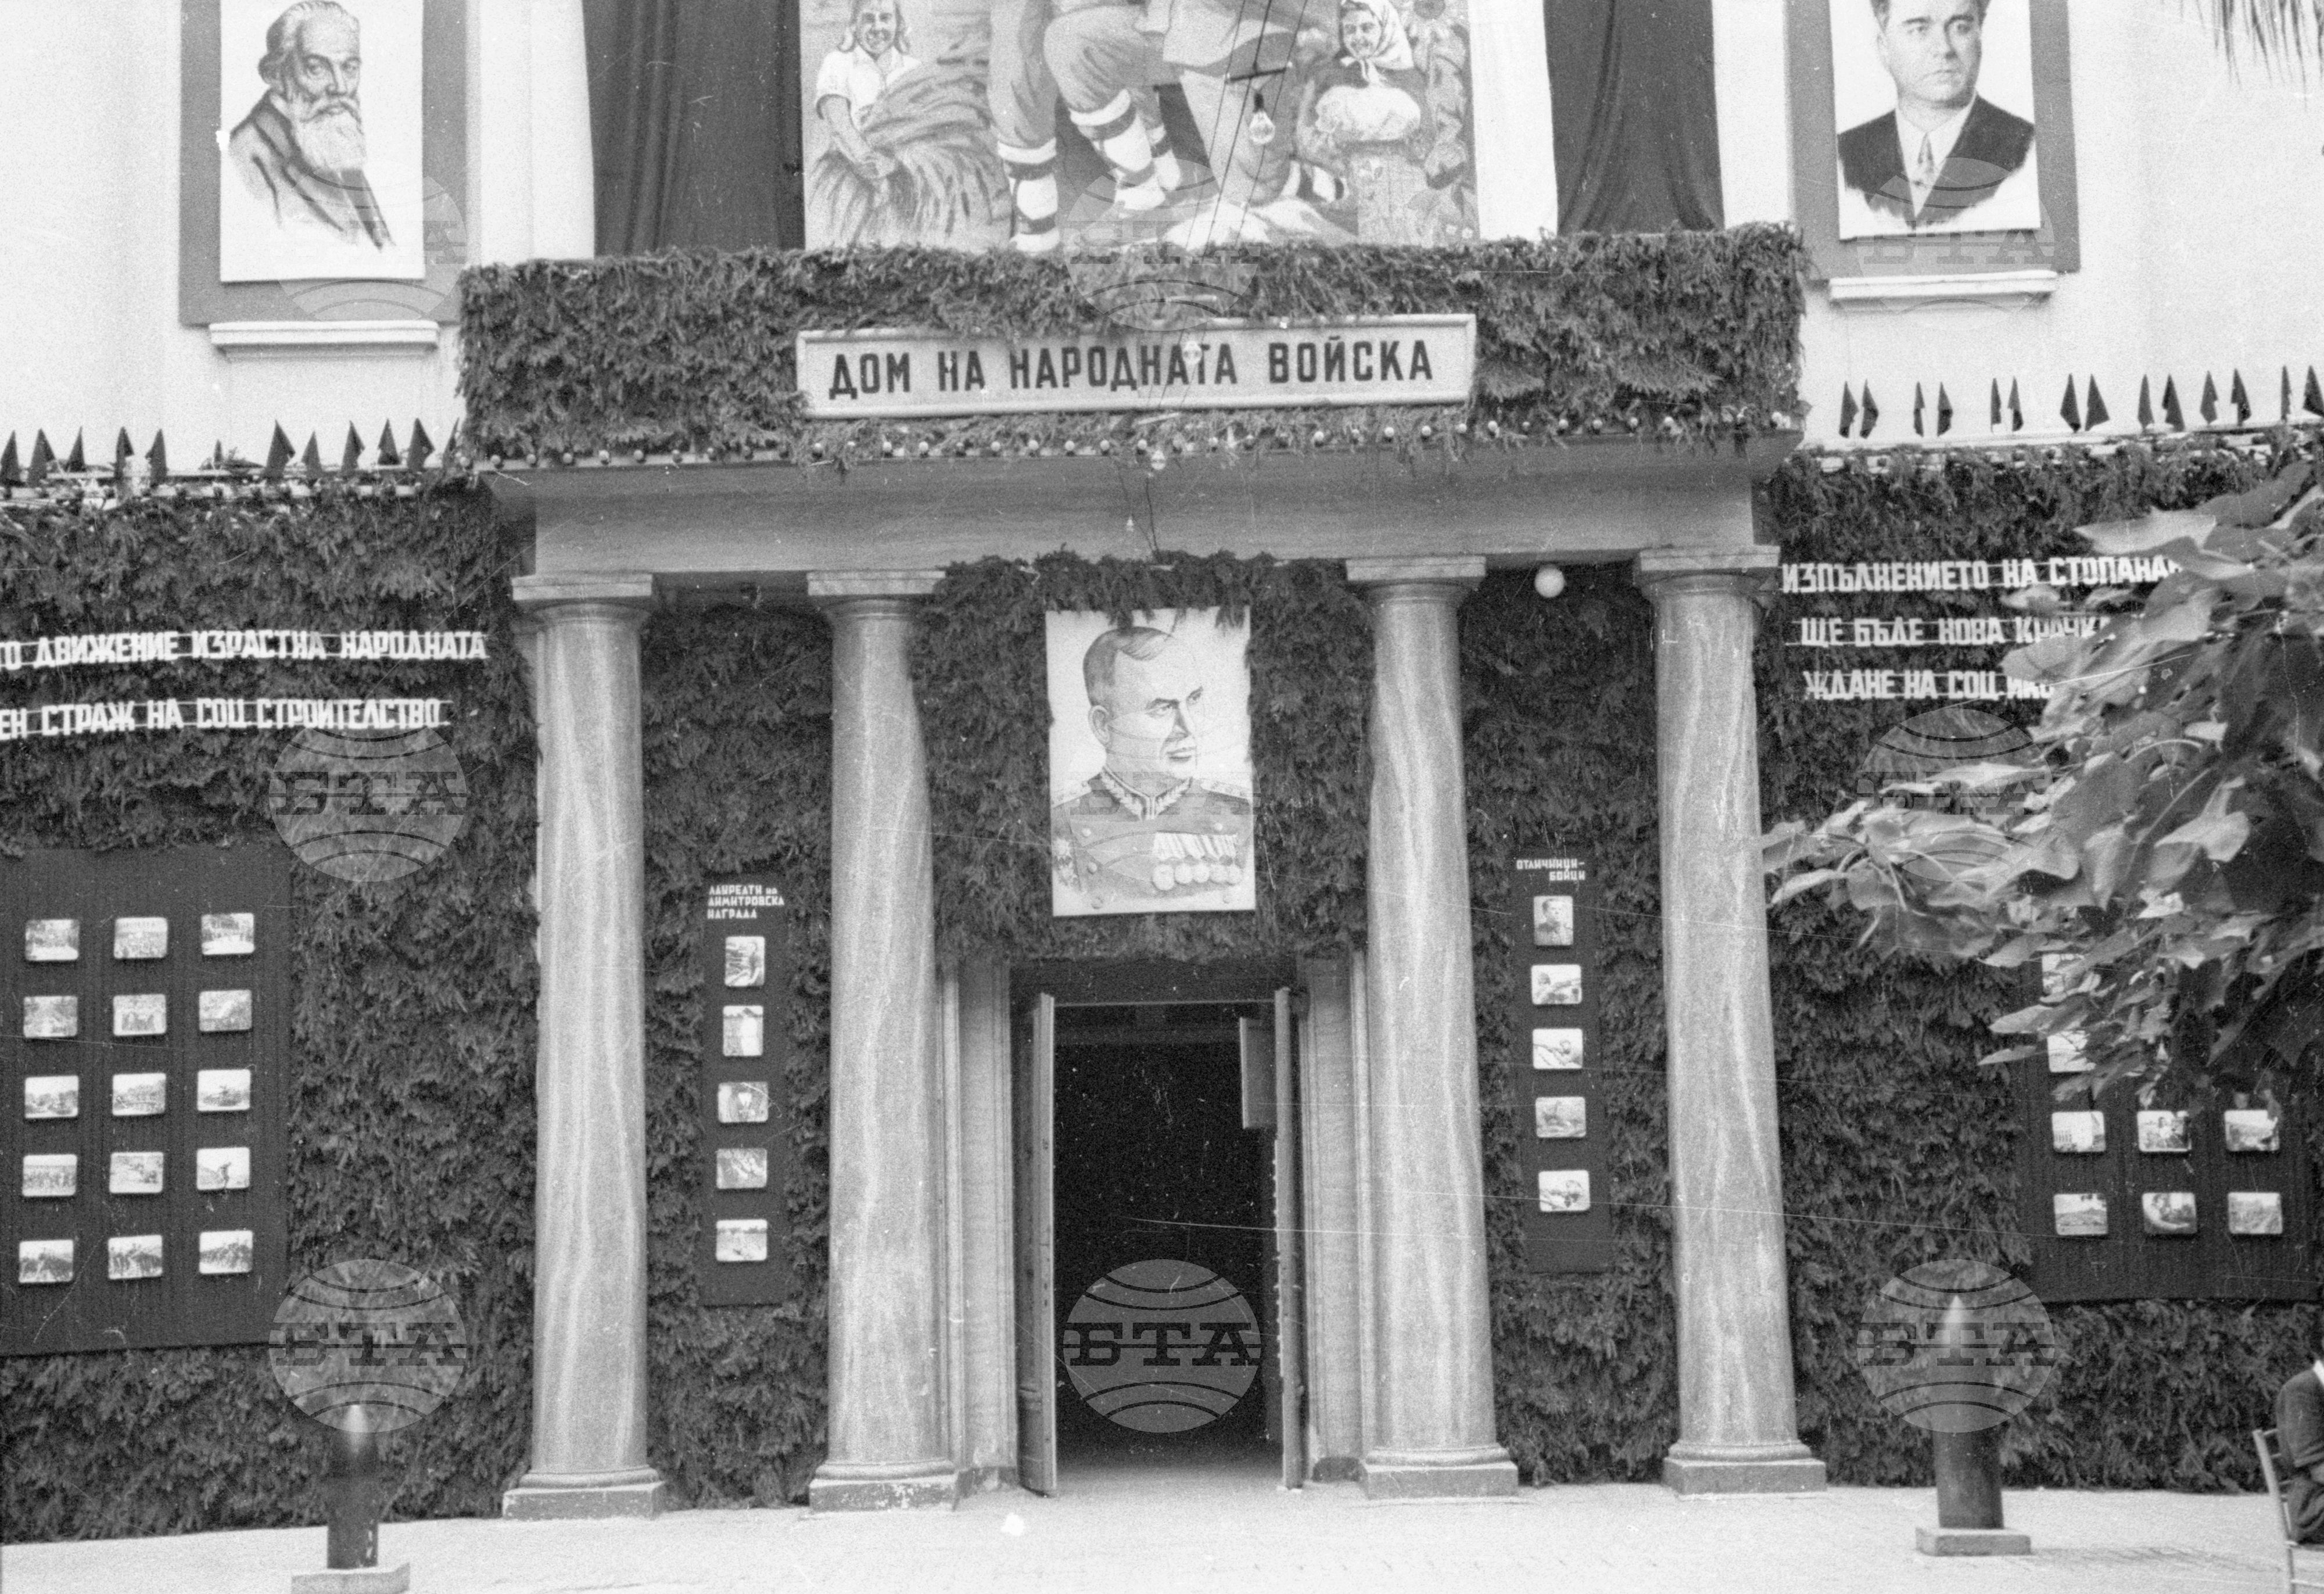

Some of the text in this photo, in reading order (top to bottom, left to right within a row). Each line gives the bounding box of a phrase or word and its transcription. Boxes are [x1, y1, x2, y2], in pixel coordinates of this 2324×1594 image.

[829, 335, 1433, 400] ДОМ НА НАРОДНАТА ВОЙСКА
[1782, 560, 1989, 593] ИЗПЪЛНЕНИЕТО
[2002, 558, 2038, 588] НА
[1801, 618, 1844, 647] ЩЕ
[1854, 617, 1924, 647] БЪДЕ
[1938, 617, 2005, 645] НОВА
[33, 631, 178, 668] ДВИЖЕНИЕ
[192, 629, 327, 660] ИЗРАСТНА
[340, 630, 487, 660] НАРОДНАТА
[1803, 669, 1896, 700] ЖДАНЕ
[1905, 669, 1938, 700] НА
[42, 701, 135, 736] СТРАЖ
[147, 699, 184, 729] НА
[708, 895, 785, 907] ДИМИТРОВСКА
[709, 884, 762, 895] ЛАУРЕАТИ
[707, 908, 757, 919] НАГРАДА
